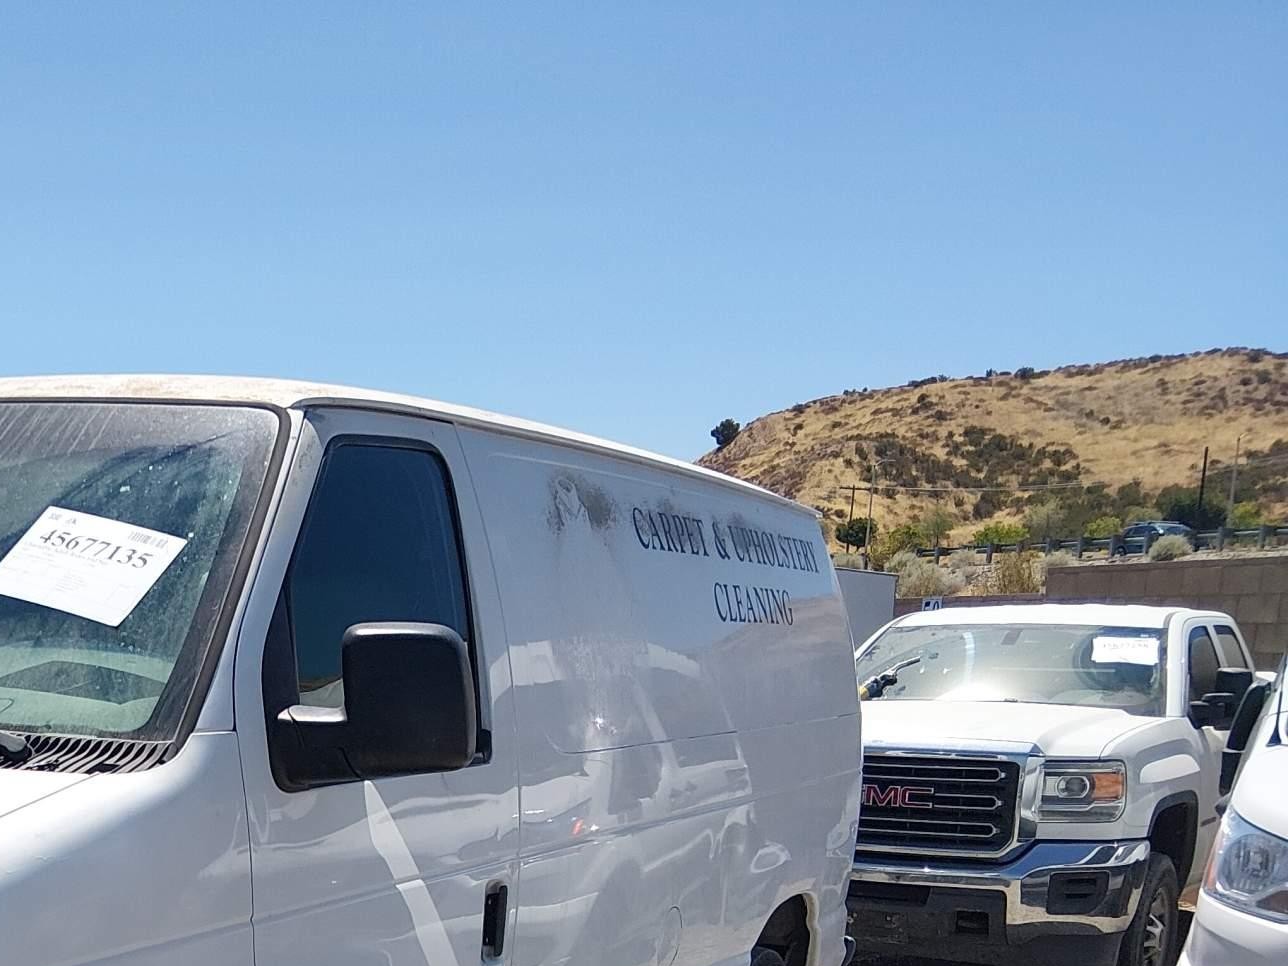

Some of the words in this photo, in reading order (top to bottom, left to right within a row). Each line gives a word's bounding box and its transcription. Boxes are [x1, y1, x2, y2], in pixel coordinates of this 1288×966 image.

[39, 528, 154, 569] 45677135
[632, 507, 710, 558] CARPET
[712, 521, 731, 560] &
[728, 525, 820, 574] UPHOLSTERY
[713, 582, 794, 626] CLEANING
[861, 783, 934, 809] MC
